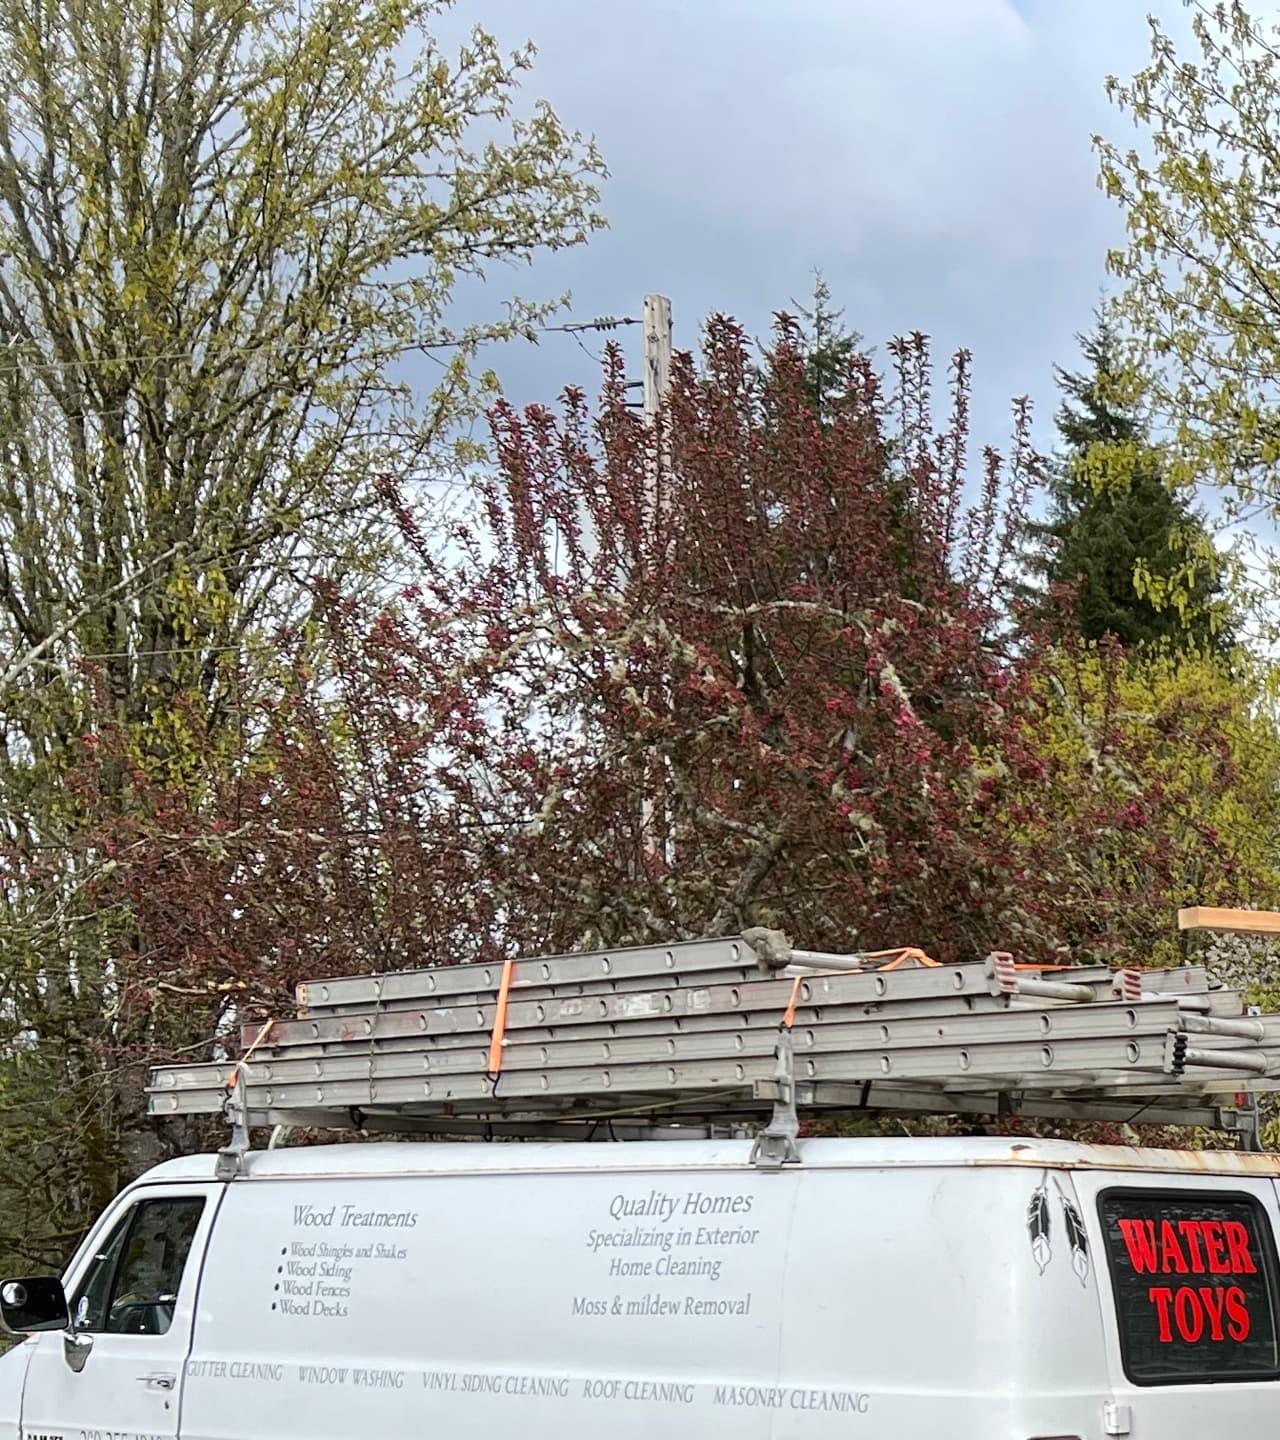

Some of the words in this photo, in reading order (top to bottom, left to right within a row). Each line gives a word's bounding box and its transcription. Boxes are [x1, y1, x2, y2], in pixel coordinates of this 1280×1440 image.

[294, 1205, 336, 1226] Wood
[341, 1205, 419, 1227] Treatments
[609, 1190, 680, 1223] Quality
[682, 1192, 754, 1214] Homes
[586, 1226, 674, 1253] Specializing
[677, 1227, 692, 1246] in
[695, 1225, 760, 1245] Exterior
[1118, 1219, 1258, 1274] WATER
[291, 1242, 316, 1257] Wood
[317, 1242, 353, 1262] Shingles
[355, 1243, 374, 1258] and
[374, 1243, 407, 1259] Shakes
[287, 1261, 317, 1276] Wood
[318, 1262, 352, 1282] Siding
[609, 1258, 652, 1276] Home
[655, 1254, 722, 1281] Cleaning
[283, 1280, 313, 1296] Wood
[315, 1281, 350, 1297] Fences
[280, 1299, 310, 1315] Wood
[313, 1300, 348, 1317] Decks
[572, 1297, 607, 1315] Moss
[611, 1295, 622, 1315] &
[626, 1293, 680, 1315] mildew
[684, 1293, 751, 1315] Removal
[1149, 1286, 1250, 1343] TOYS
[187, 1360, 226, 1378] GUTTER
[229, 1361, 284, 1382] CLEANING
[299, 1365, 349, 1384] WINDOW
[352, 1368, 405, 1389] WASHING
[423, 1372, 457, 1391] VINYL
[461, 1373, 502, 1393] SIDING
[505, 1375, 569, 1397] CLEANING
[583, 1379, 621, 1399] ROOF
[624, 1380, 695, 1403] CLEANING
[712, 1385, 786, 1408] MASONRY
[790, 1389, 870, 1414] CLEANING
